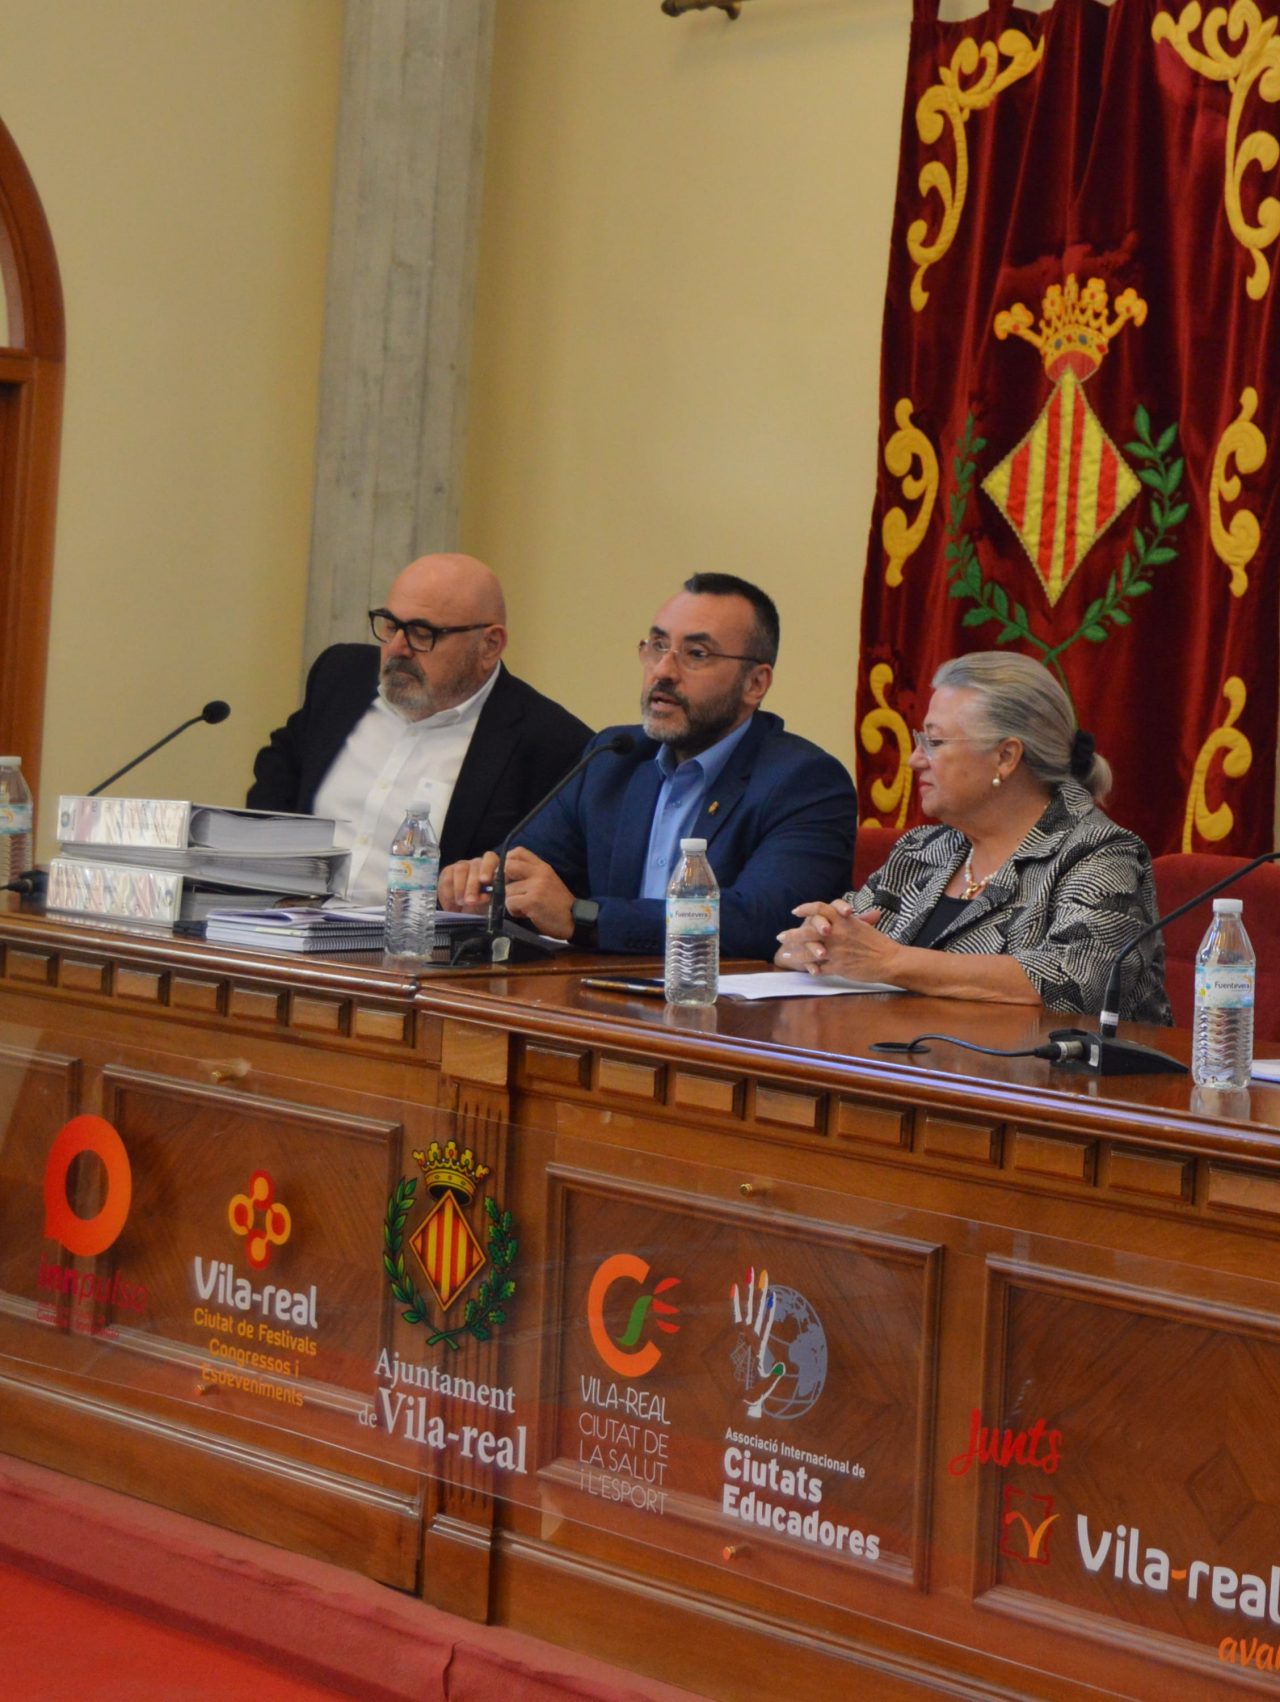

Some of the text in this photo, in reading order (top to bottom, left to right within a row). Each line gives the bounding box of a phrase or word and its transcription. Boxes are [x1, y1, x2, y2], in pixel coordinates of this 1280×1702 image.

[194, 1256, 318, 1329] Vila-real
[193, 1307, 317, 1356] Ciutat de Festivals
[208, 1338, 300, 1377] Congressos i
[201, 1362, 304, 1406] Esdeveniments
[374, 1347, 516, 1414] Ajuntament
[580, 1375, 671, 1425] VILA-REAL
[358, 1387, 528, 1474] de Vila-real
[578, 1412, 669, 1459] CIUTAT DE
[725, 1426, 866, 1478] Associació Internacional de
[947, 1407, 1062, 1477] Junts
[579, 1439, 667, 1486] LA SALUT
[724, 1447, 822, 1503] Ciutats
[722, 1483, 880, 1560] Educadores
